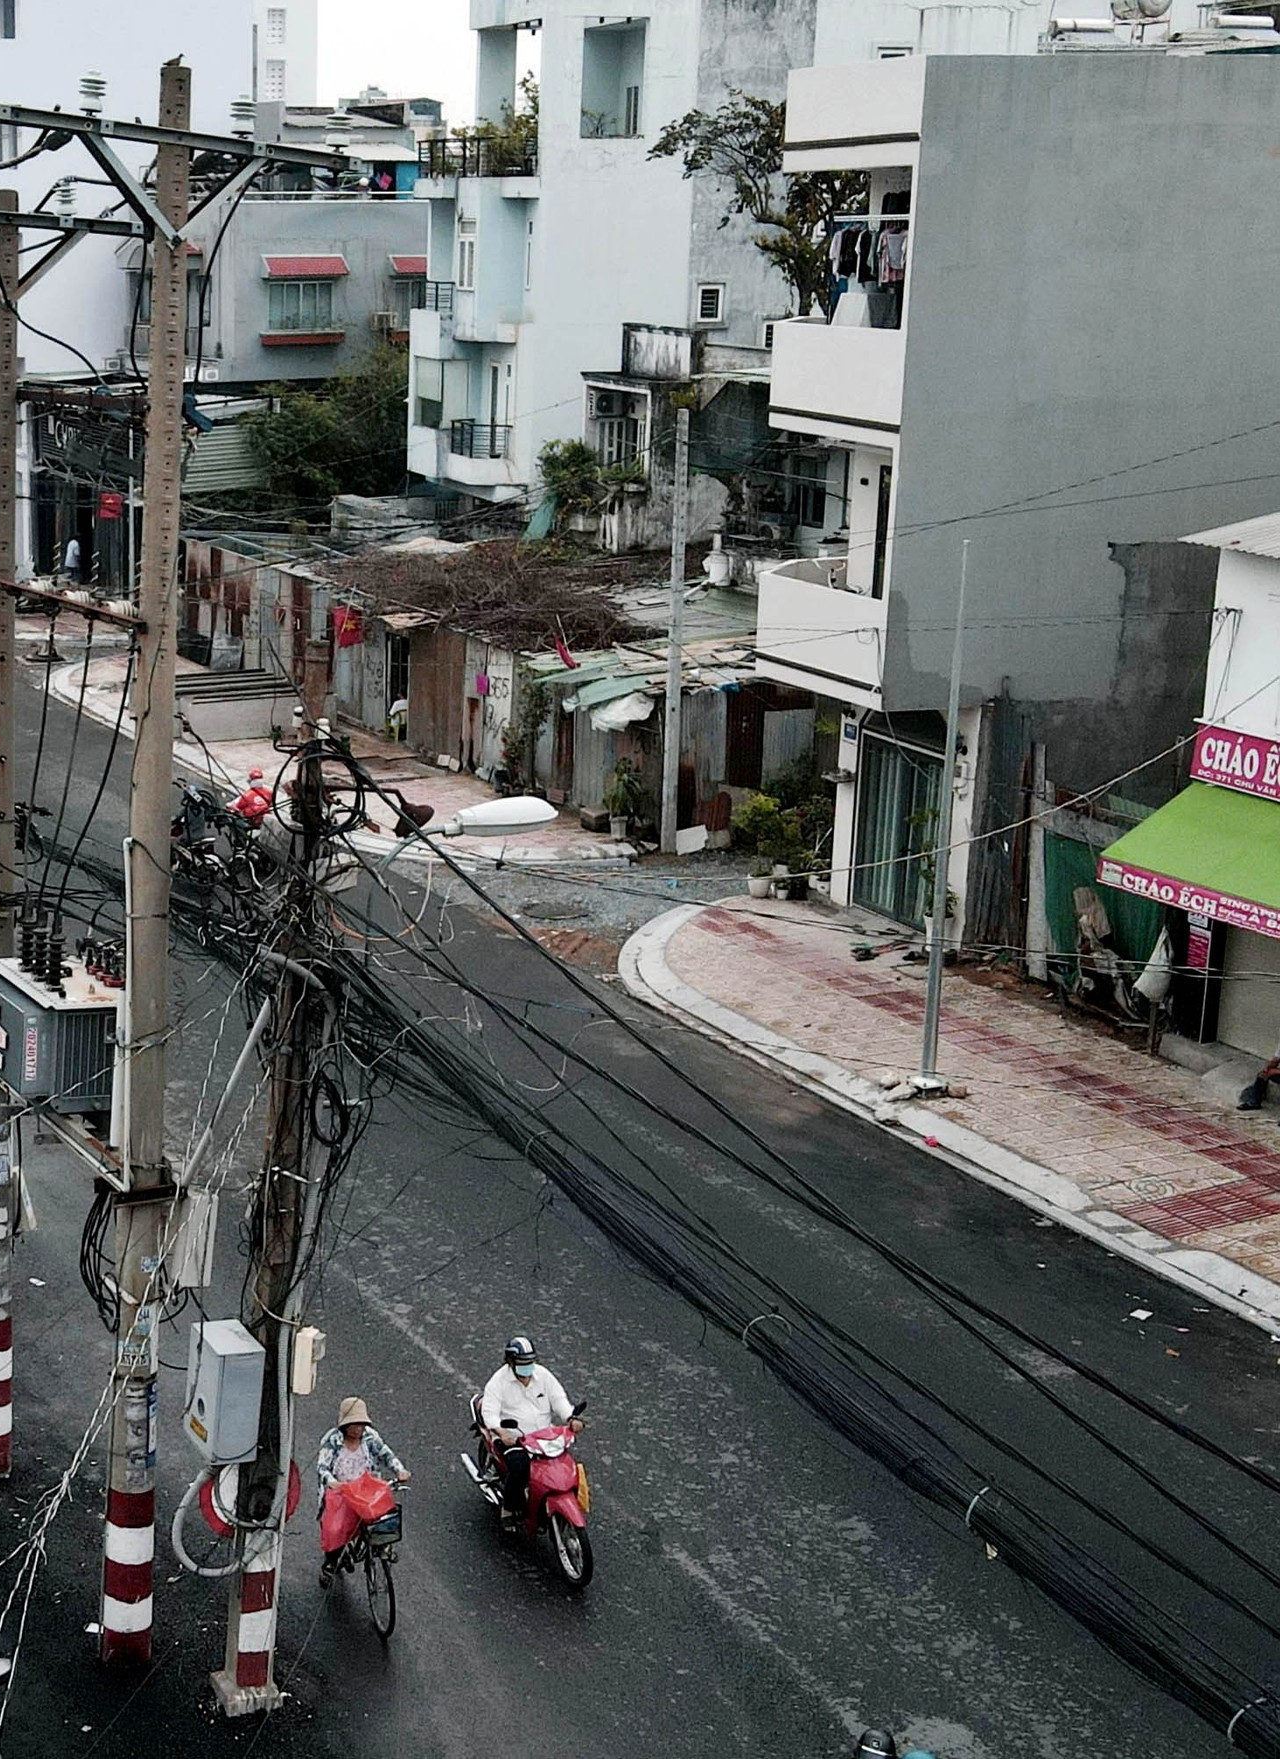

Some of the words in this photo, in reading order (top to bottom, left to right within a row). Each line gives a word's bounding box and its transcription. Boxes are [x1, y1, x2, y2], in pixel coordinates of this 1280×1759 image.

[1201, 736, 1260, 779] CHÁO
[1122, 873, 1175, 901] CHÁO
[1178, 886, 1218, 915] ẾCH
